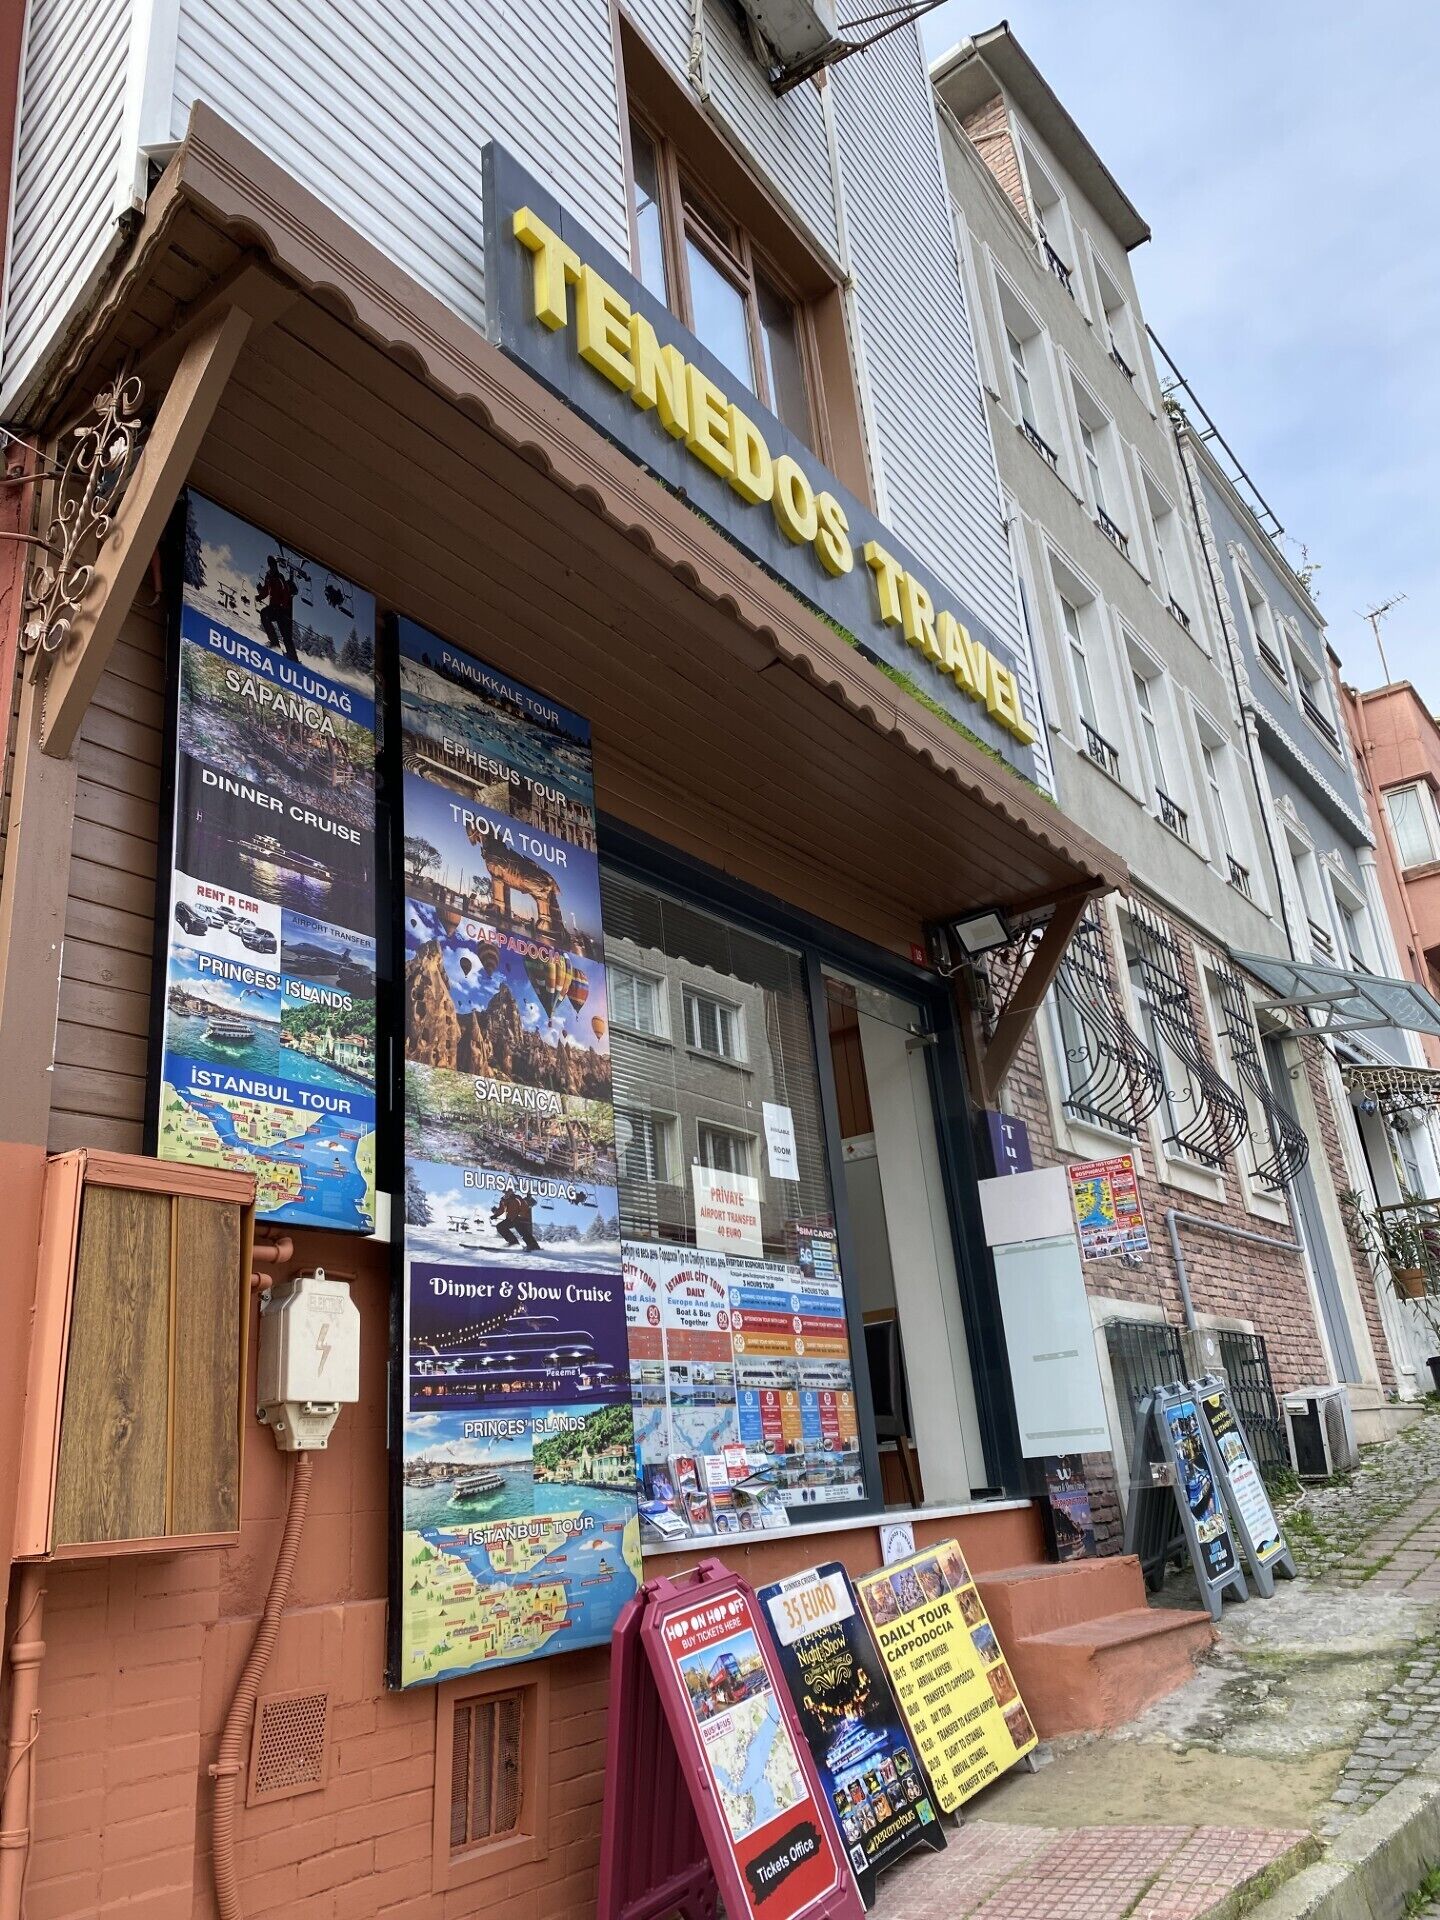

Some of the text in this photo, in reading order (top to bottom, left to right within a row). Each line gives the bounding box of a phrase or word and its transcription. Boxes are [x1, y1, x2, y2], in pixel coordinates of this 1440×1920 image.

[512, 205, 1037, 745] TENEDOS TRAVEL
[209, 628, 352, 713] BURSA ULUDAĞ
[225, 668, 336, 738] SAPANCA
[442, 651, 559, 726] PAMUKKALE TOUR
[442, 736, 567, 807] EPHESUS TOUR
[202, 768, 361, 845] DINNER CRUISE
[449, 803, 568, 868] TROYA TOUR
[196, 884, 259, 914] RENT A CAR
[291, 916, 371, 948] AIRPORT TRANSFER
[465, 922, 561, 966] CAPPADOCIA
[284, 978, 353, 1012] ISLANDS
[191, 1066, 351, 1115] İSTANBUL TOUR
[475, 1078, 562, 1115] SAPANCA
[773, 1145, 791, 1156] ROOM
[463, 1170, 577, 1201] BURSA ULUDAĞ
[717, 1227, 742, 1240] 40 EURO
[727, 1212, 757, 1226] TRANSFER
[799, 1226, 834, 1239] SIM CARD
[800, 1248, 813, 1262] 5G
[429, 1277, 495, 1298] Dinner
[499, 1281, 514, 1298] &
[517, 1281, 562, 1301] Show
[566, 1284, 612, 1303] Cruise
[640, 1269, 657, 1292] TOUR
[686, 1287, 705, 1298] DAILY
[710, 1277, 725, 1299] TOUR
[626, 1304, 640, 1312] Bus
[639, 1294, 656, 1303] Asia
[648, 1306, 658, 1318] 80
[667, 1297, 725, 1309] Europe And Asia
[676, 1308, 691, 1317] Boat
[699, 1309, 711, 1318] Bus
[680, 1317, 708, 1327] Together
[718, 1312, 727, 1323] 80
[532, 1416, 586, 1433] ISLANDS
[468, 1523, 549, 1546] İSTANBUL
[552, 1516, 594, 1534] TOUR
[783, 1573, 817, 1592] DINNER CRUISE
[665, 1598, 744, 1642] HOP ON HOP OFF
[783, 1583, 837, 1629] 35 EURO
[681, 1616, 742, 1650] BUY TICKETS HERE
[879, 1602, 951, 1648] DAILY TOUR
[796, 1643, 823, 1667] Night
[822, 1634, 846, 1657] Show
[887, 1620, 954, 1662] CAPPODOCIA
[910, 1654, 927, 1672] FLIGHT
[925, 1651, 933, 1662] TO
[916, 1670, 936, 1689] ARRIVAL
[923, 1684, 947, 1706] TRANSFER
[944, 1682, 952, 1693] TO
[930, 1711, 940, 1725] DAY
[939, 1703, 952, 1719] TOUR
[937, 1720, 960, 1742] TRANSFER
[957, 1716, 966, 1728] TO
[979, 1695, 996, 1714] AIRPORT
[943, 1742, 961, 1760] FLIGHT
[958, 1738, 967, 1750] TO
[934, 1773, 949, 1791] 21:45
[951, 1758, 971, 1779] ARRIVAL
[957, 1773, 981, 1796] TRANSFER
[977, 1768, 986, 1781] TO
[756, 1838, 814, 1884] Tickets Office
